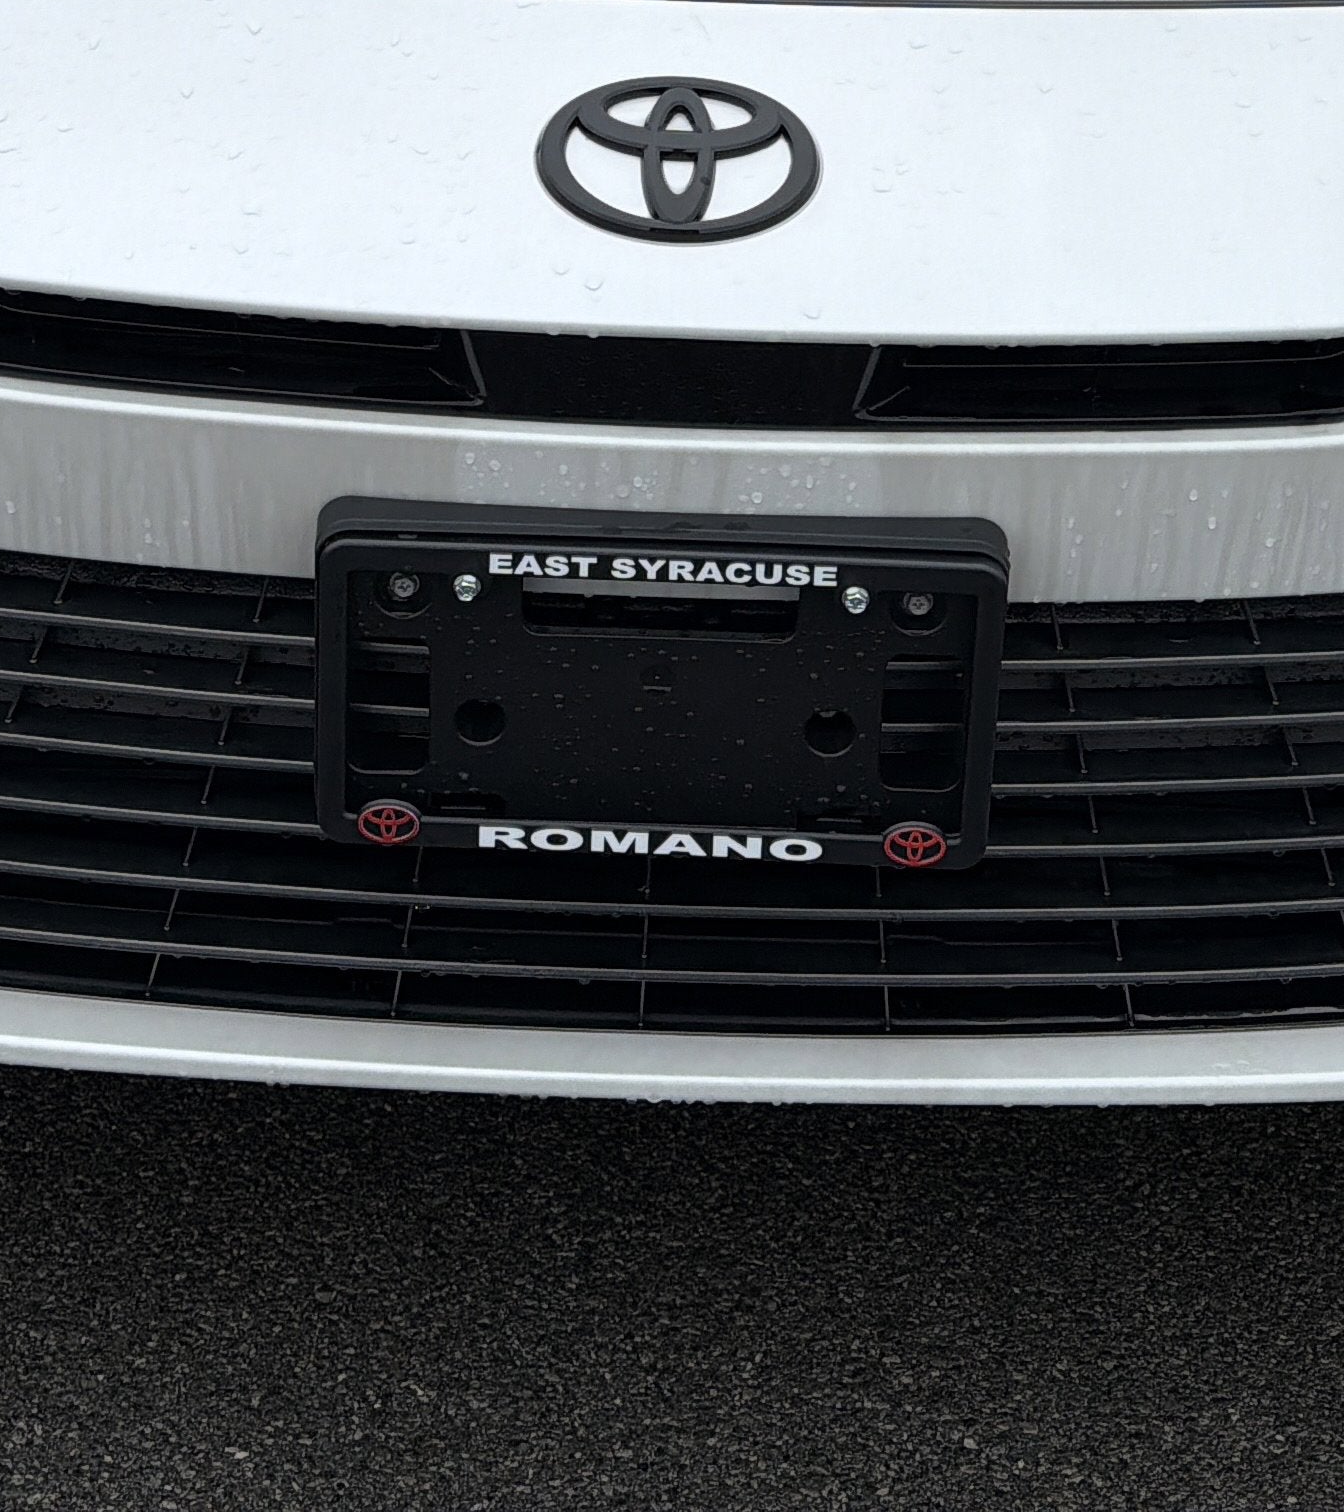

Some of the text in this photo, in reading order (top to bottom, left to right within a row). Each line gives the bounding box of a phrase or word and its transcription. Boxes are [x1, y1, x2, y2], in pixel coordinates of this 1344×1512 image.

[488, 552, 838, 587] EAST SYRACUSE
[478, 825, 823, 862] ROMANO
